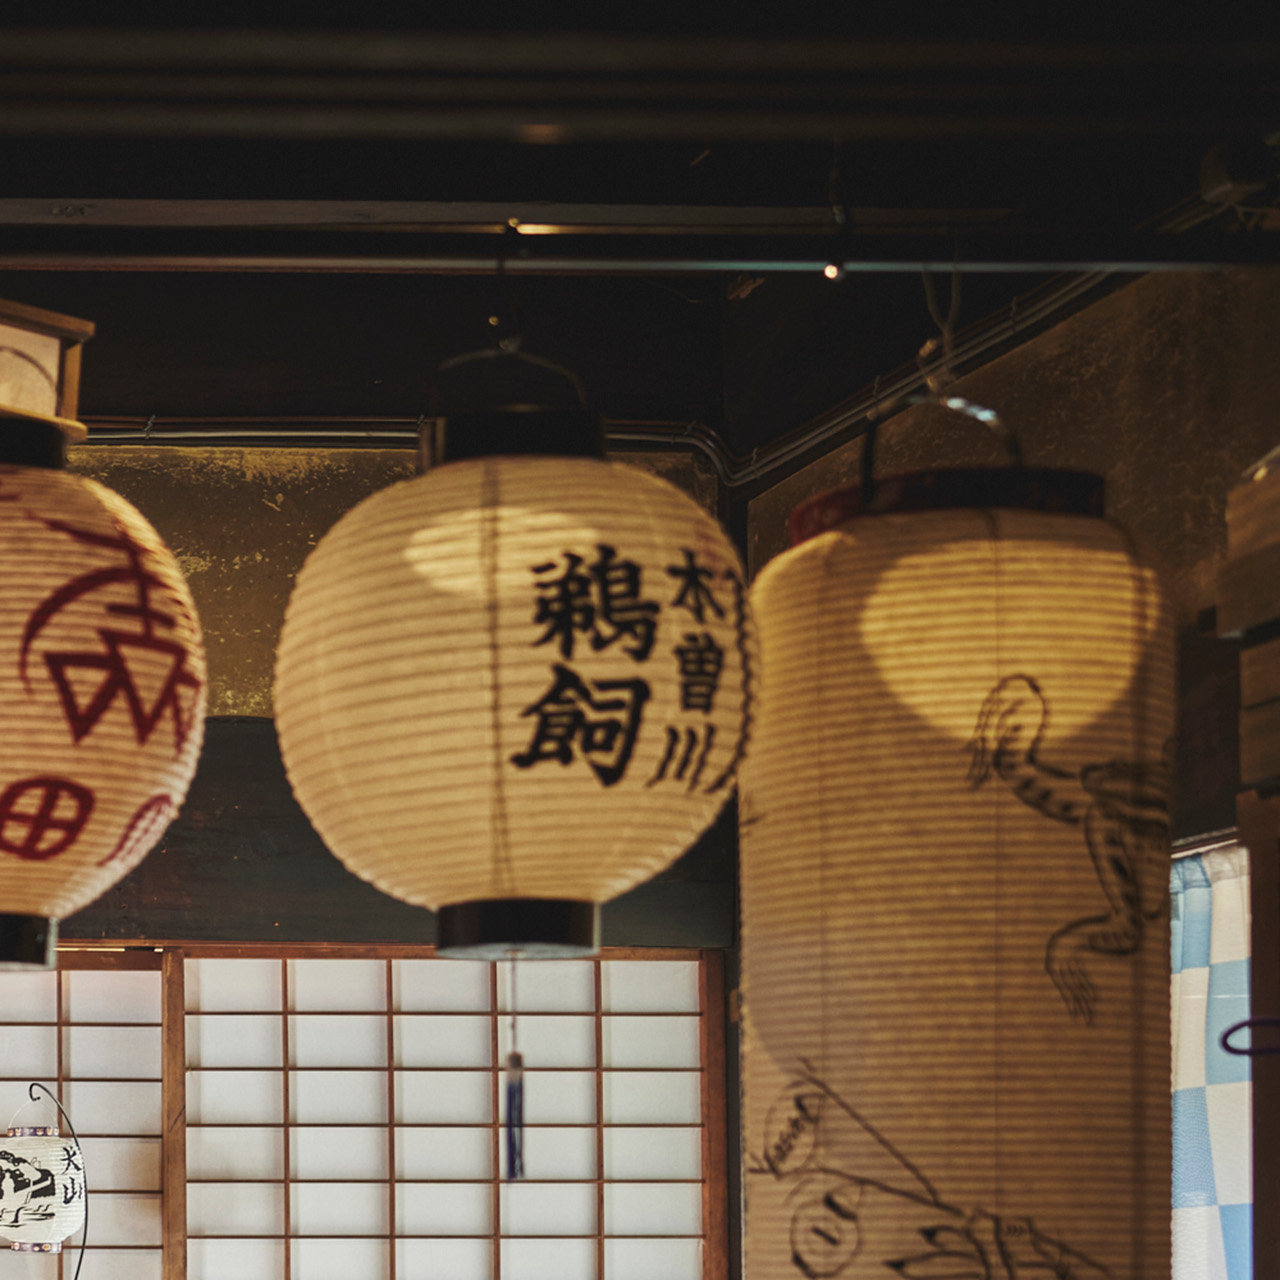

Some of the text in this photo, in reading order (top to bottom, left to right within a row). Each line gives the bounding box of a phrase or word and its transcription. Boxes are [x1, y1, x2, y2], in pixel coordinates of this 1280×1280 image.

[511, 543, 661, 787] 鵜飼
[645, 548, 725, 793] 木曽川
[60, 1146, 83, 1205] 犬山
